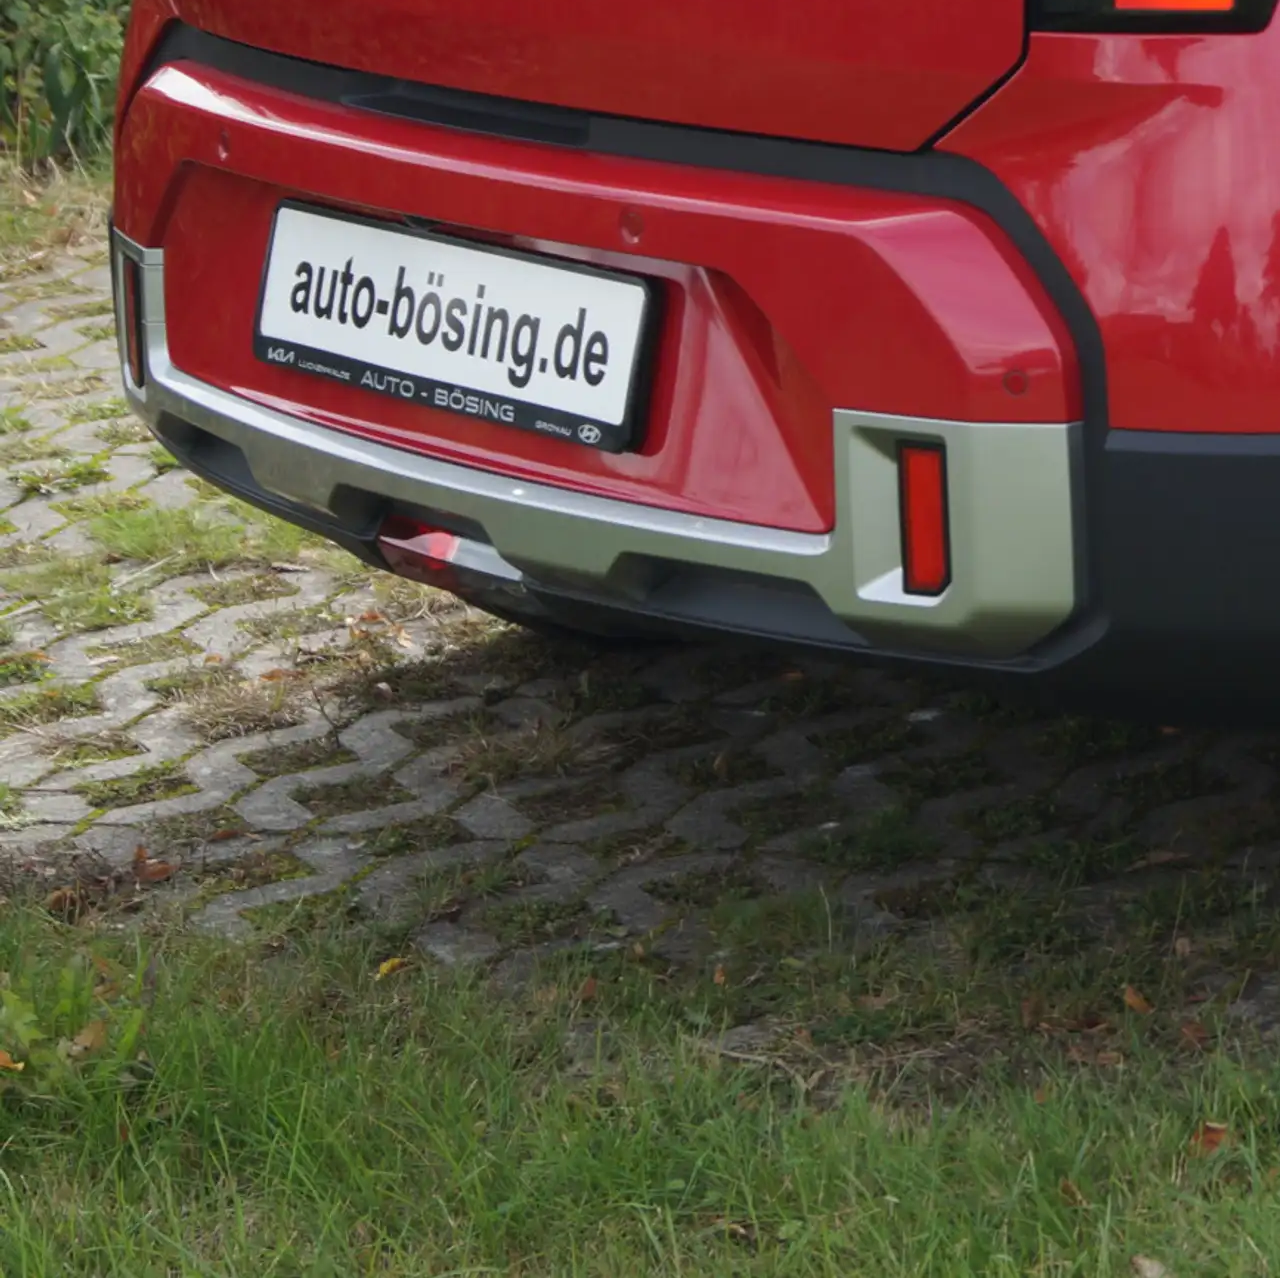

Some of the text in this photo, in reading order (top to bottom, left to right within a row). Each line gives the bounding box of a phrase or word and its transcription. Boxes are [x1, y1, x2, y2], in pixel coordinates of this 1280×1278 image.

[290, 256, 609, 389] auto-bösing.de
[268, 346, 295, 364] KIA
[361, 370, 415, 398] AUTO
[434, 387, 516, 423] BÖSING
